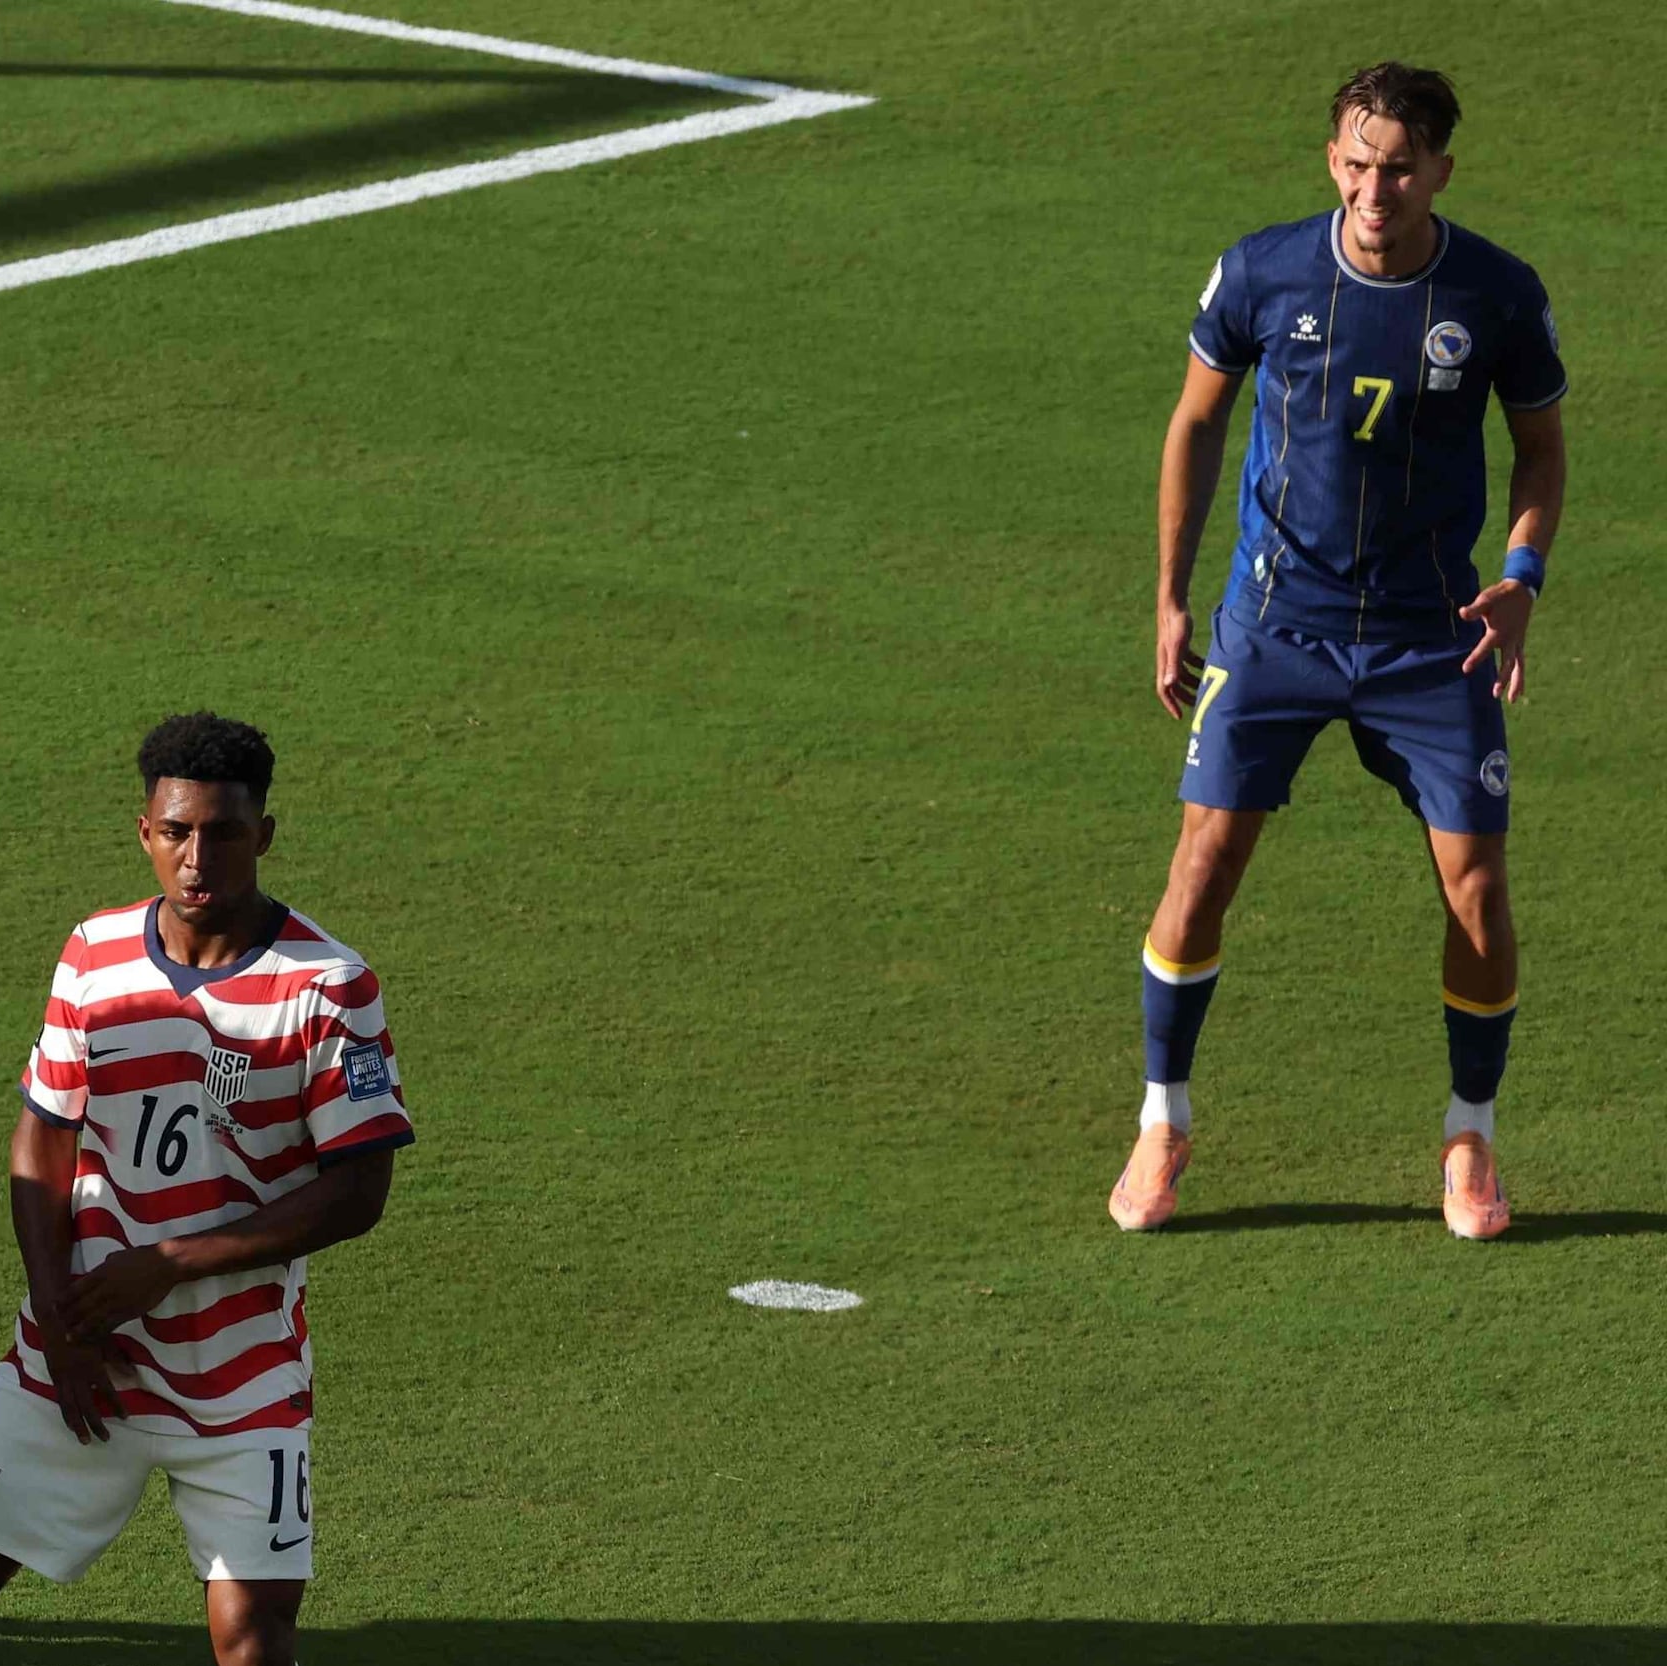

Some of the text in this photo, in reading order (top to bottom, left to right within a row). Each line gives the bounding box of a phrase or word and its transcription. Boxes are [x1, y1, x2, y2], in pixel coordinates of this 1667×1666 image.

[1289, 331, 1322, 343] KELME
[1352, 376, 1395, 442] 7
[1191, 664, 1229, 735] 7
[211, 1050, 249, 1075] USA
[352, 1059, 382, 1076] UNITES
[133, 1094, 199, 1177] 16
[268, 1448, 310, 1524] 16
